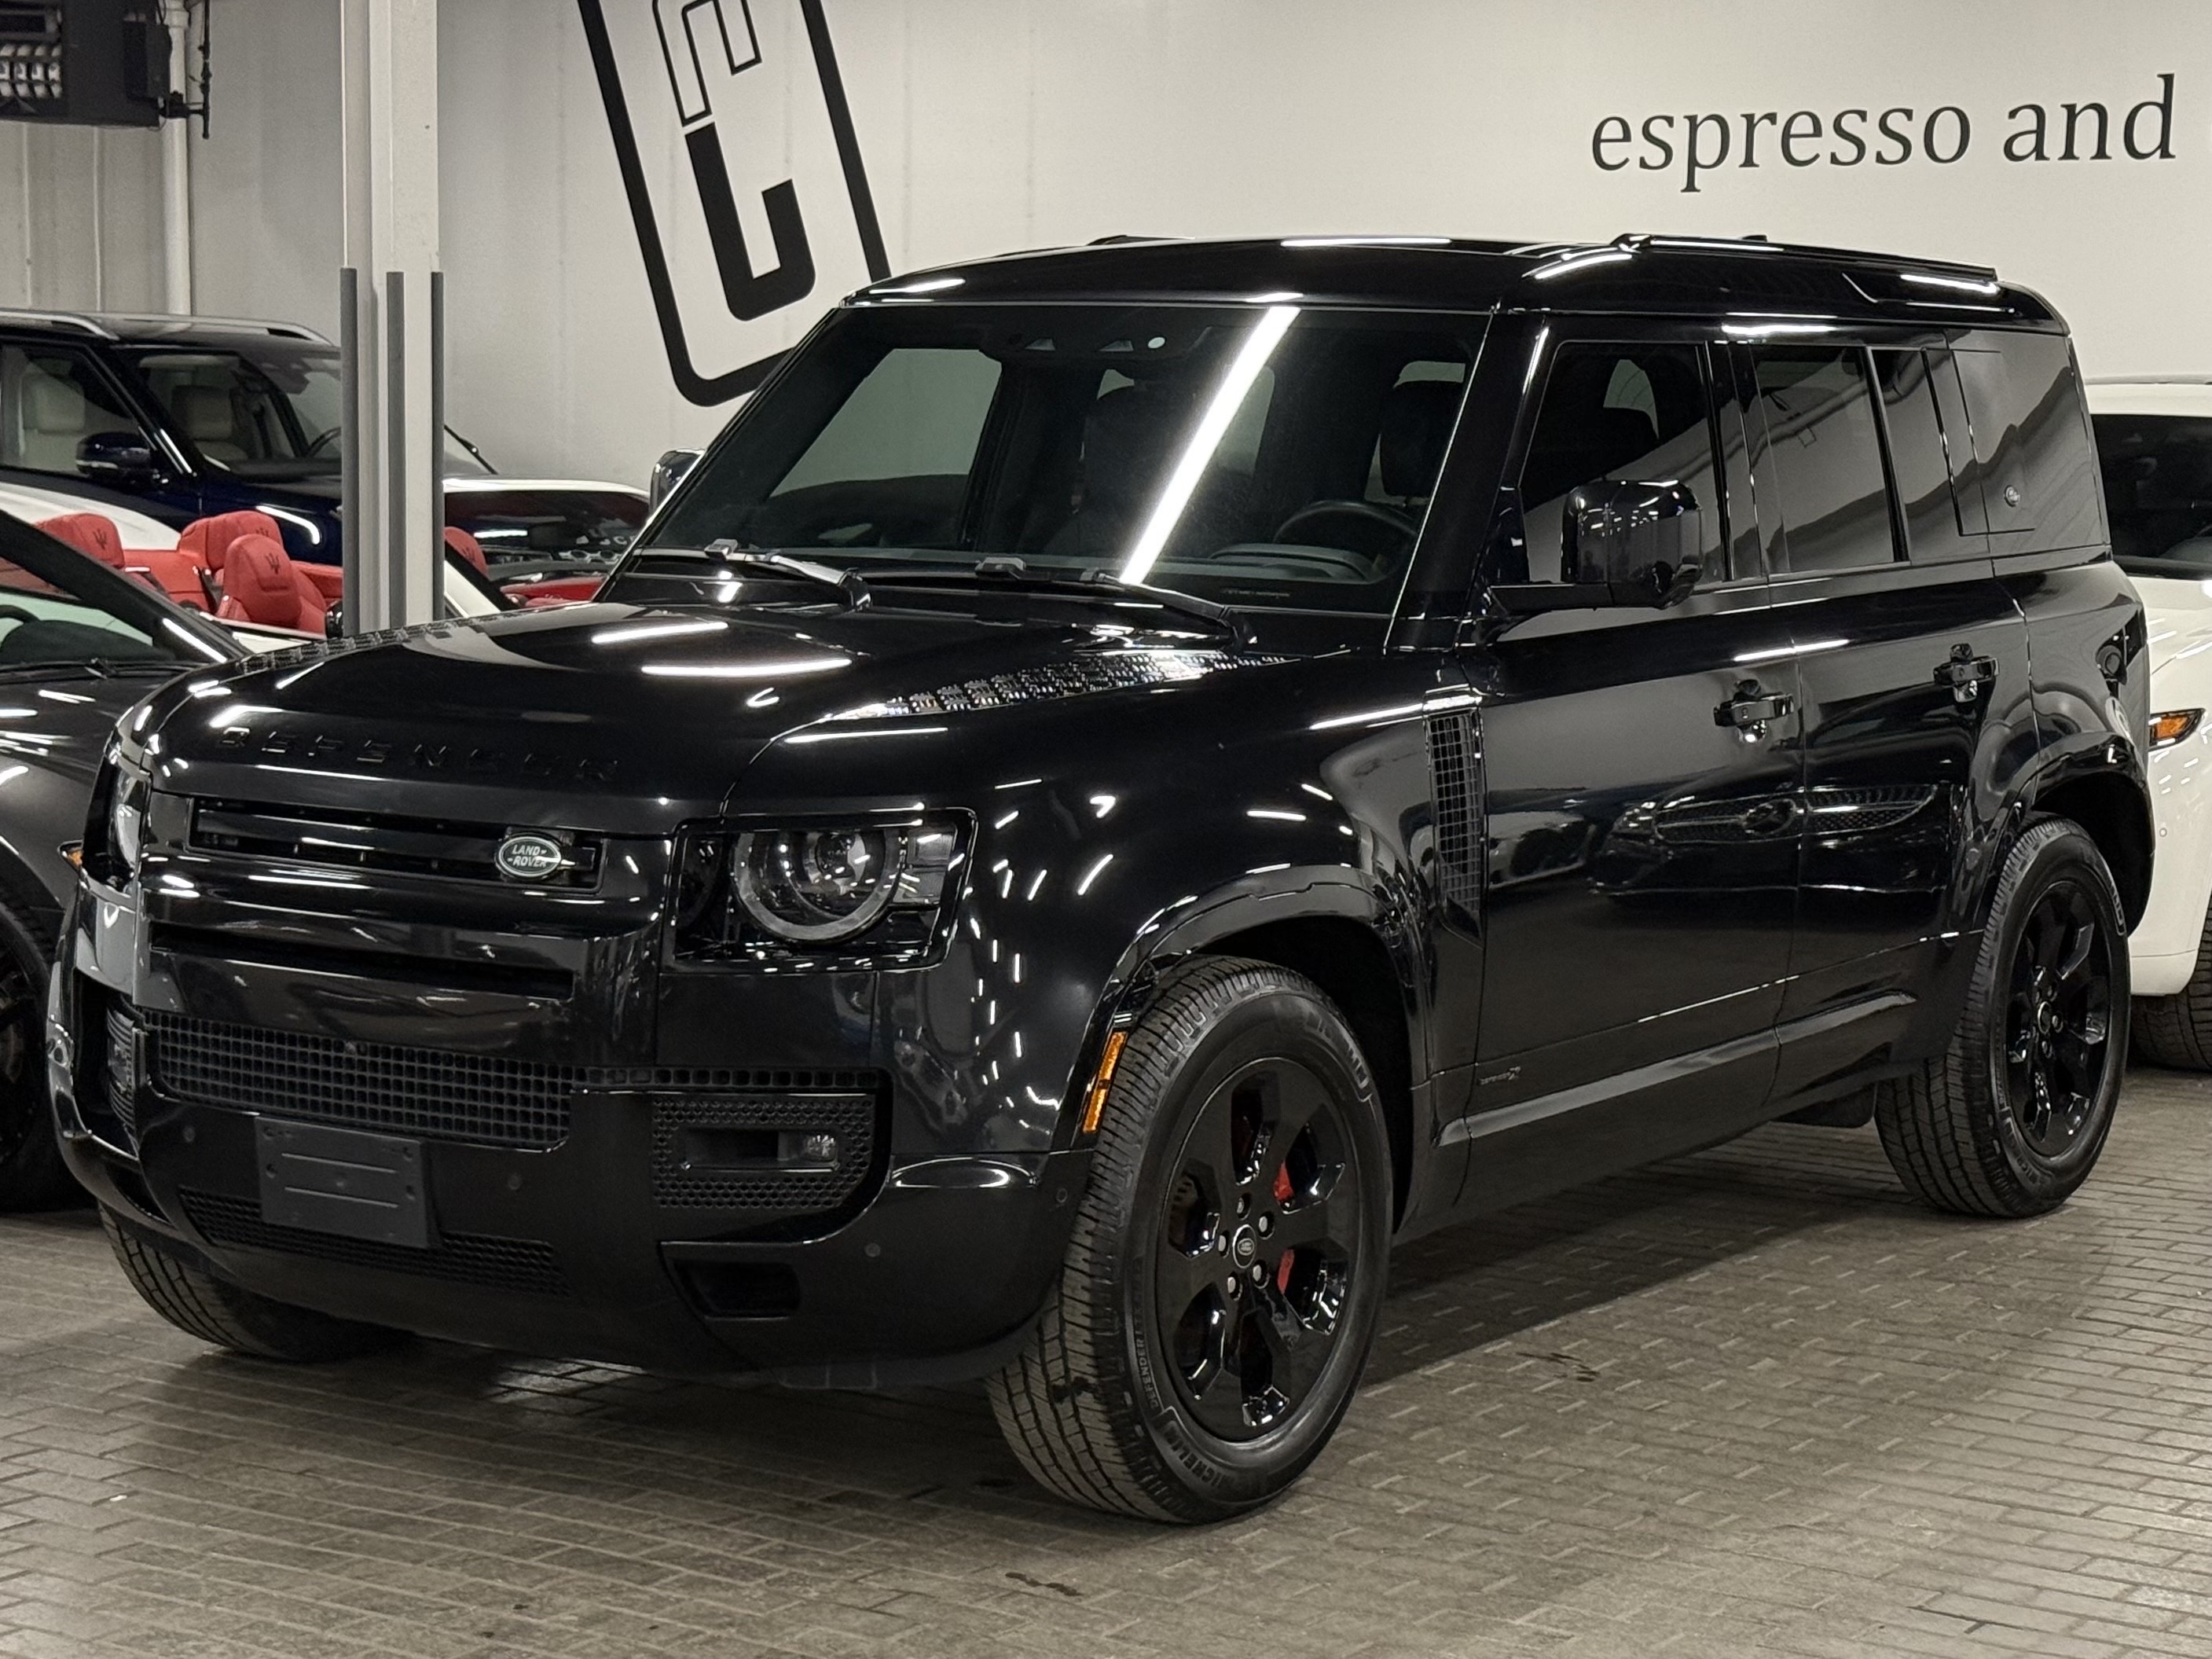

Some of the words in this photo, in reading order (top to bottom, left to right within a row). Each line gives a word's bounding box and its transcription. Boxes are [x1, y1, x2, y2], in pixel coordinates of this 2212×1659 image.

[1592, 104, 1972, 193] espresso
[2003, 74, 2176, 162] and
[512, 844, 541, 856] LAND
